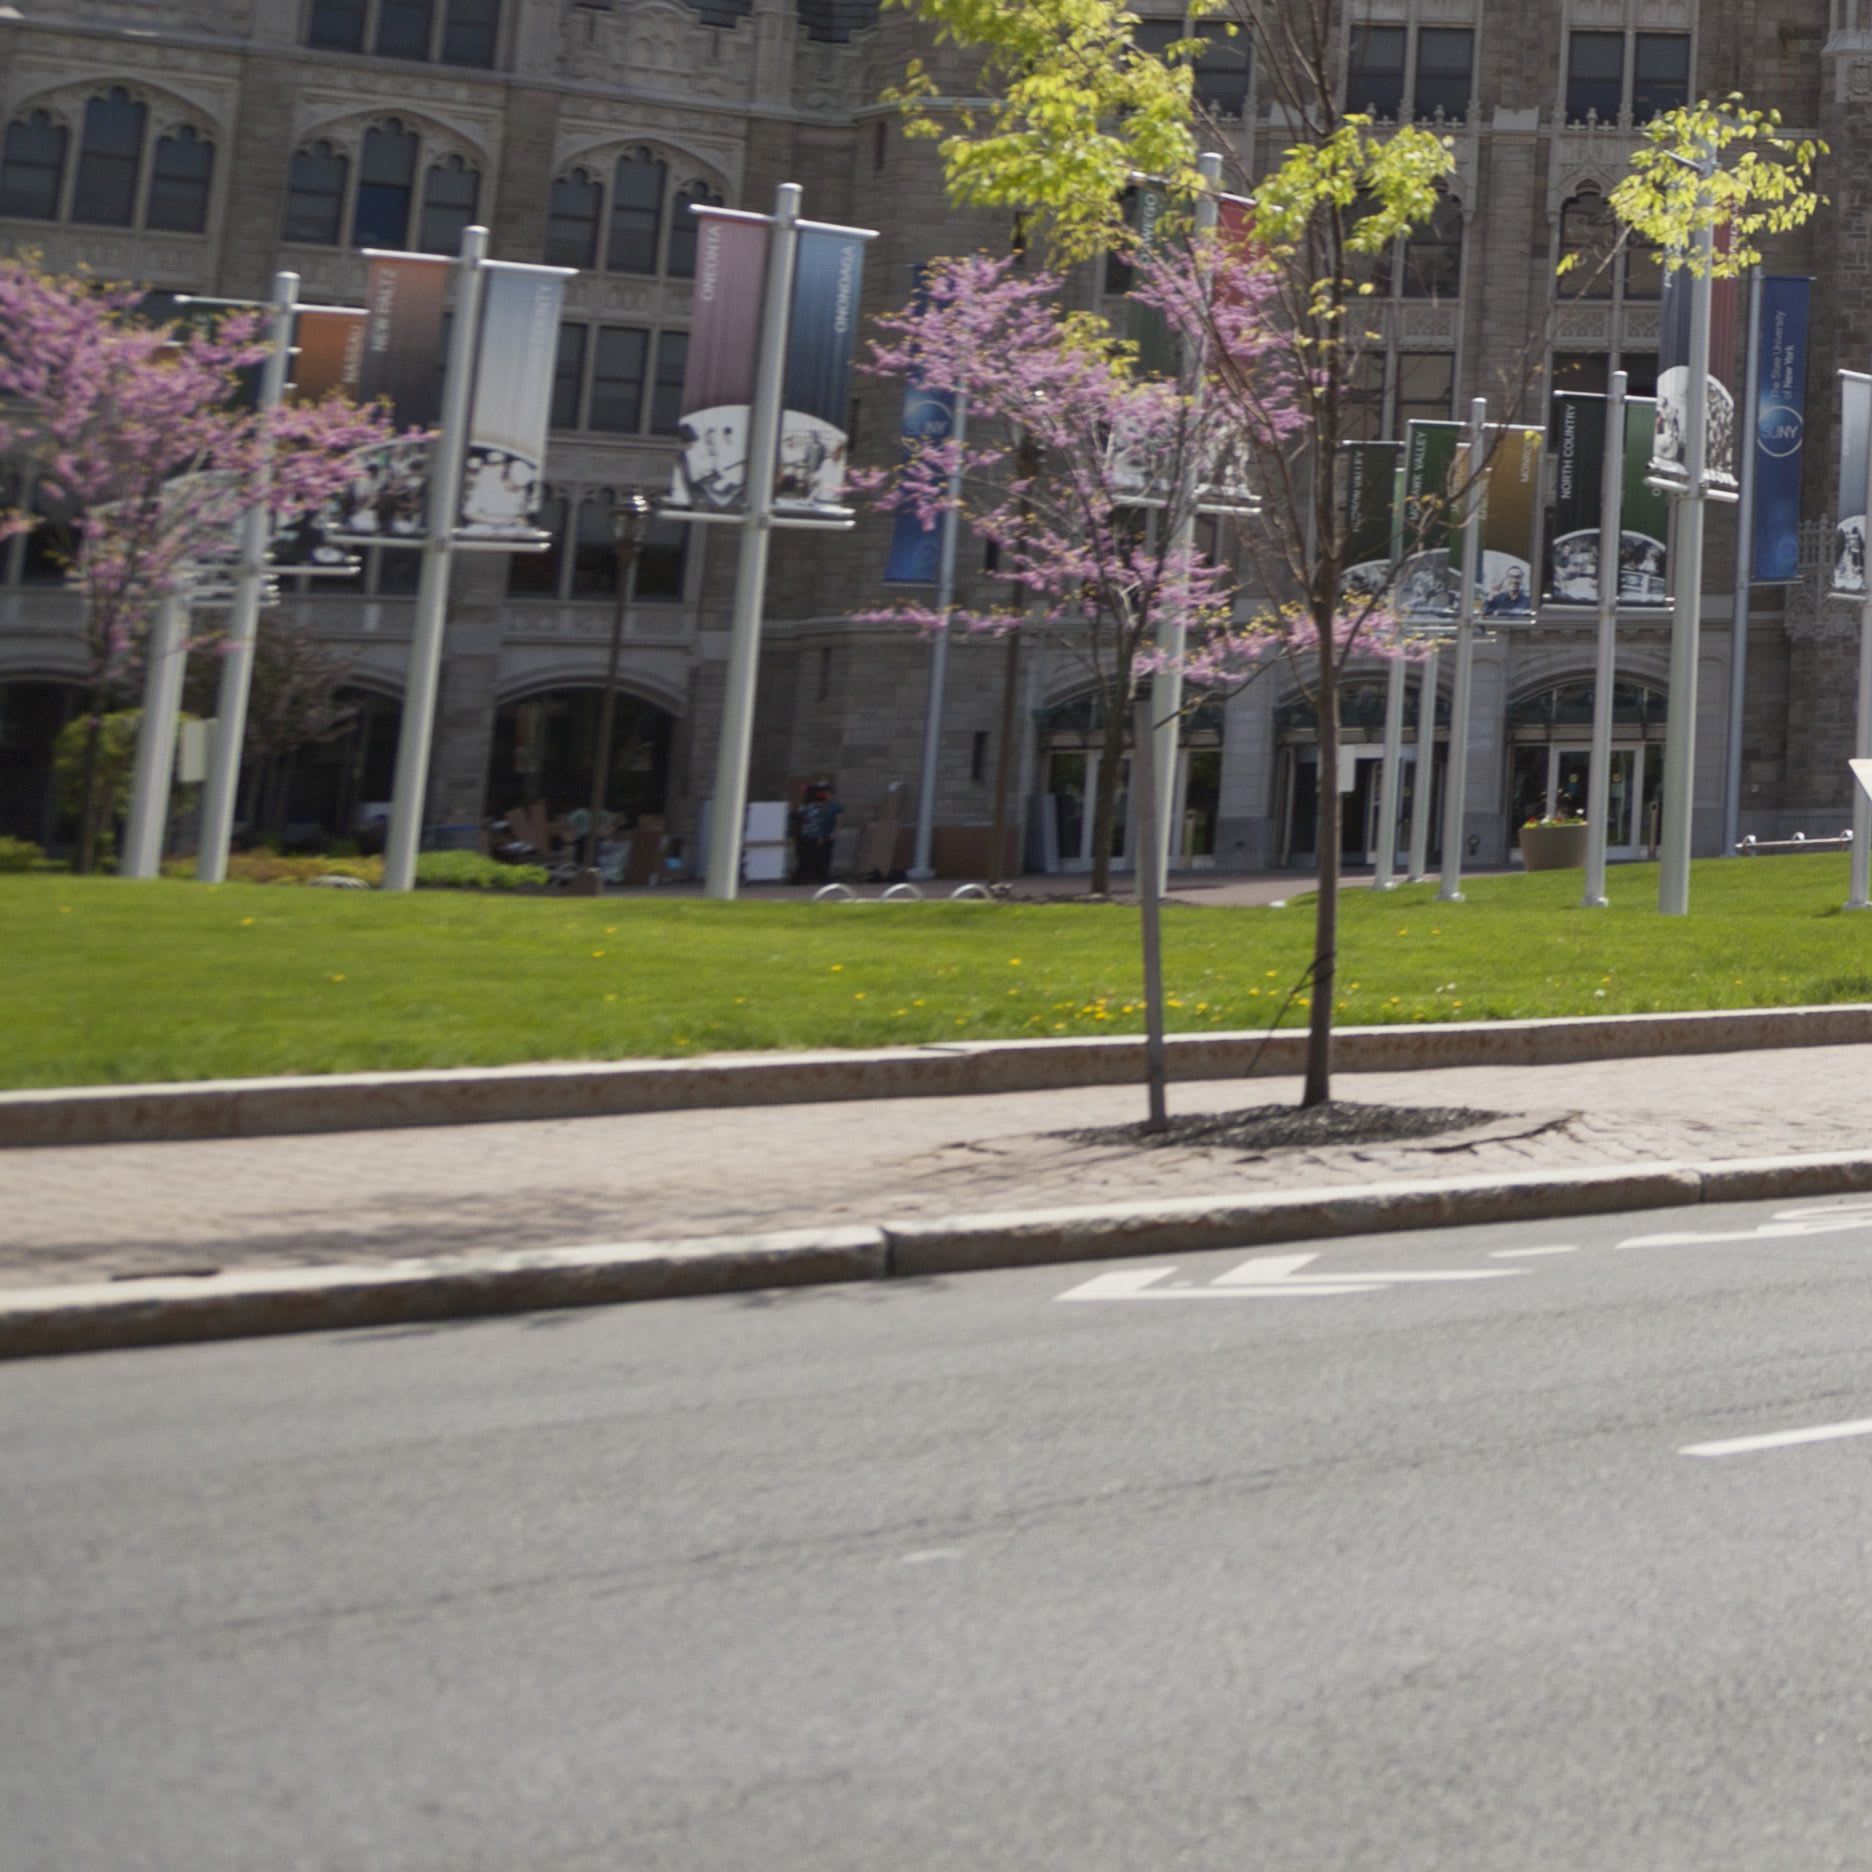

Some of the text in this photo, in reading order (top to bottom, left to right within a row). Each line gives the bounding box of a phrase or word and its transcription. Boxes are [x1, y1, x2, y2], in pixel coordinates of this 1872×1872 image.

[1139, 194, 1156, 263] OWEGO
[835, 245, 855, 333] ONONDAGA
[1773, 310, 1787, 355] University
[1561, 404, 1576, 500] NORTH COUNTRY
[1760, 423, 1798, 439] SUNY
[1409, 431, 1427, 521] MOAWK VALLEY
